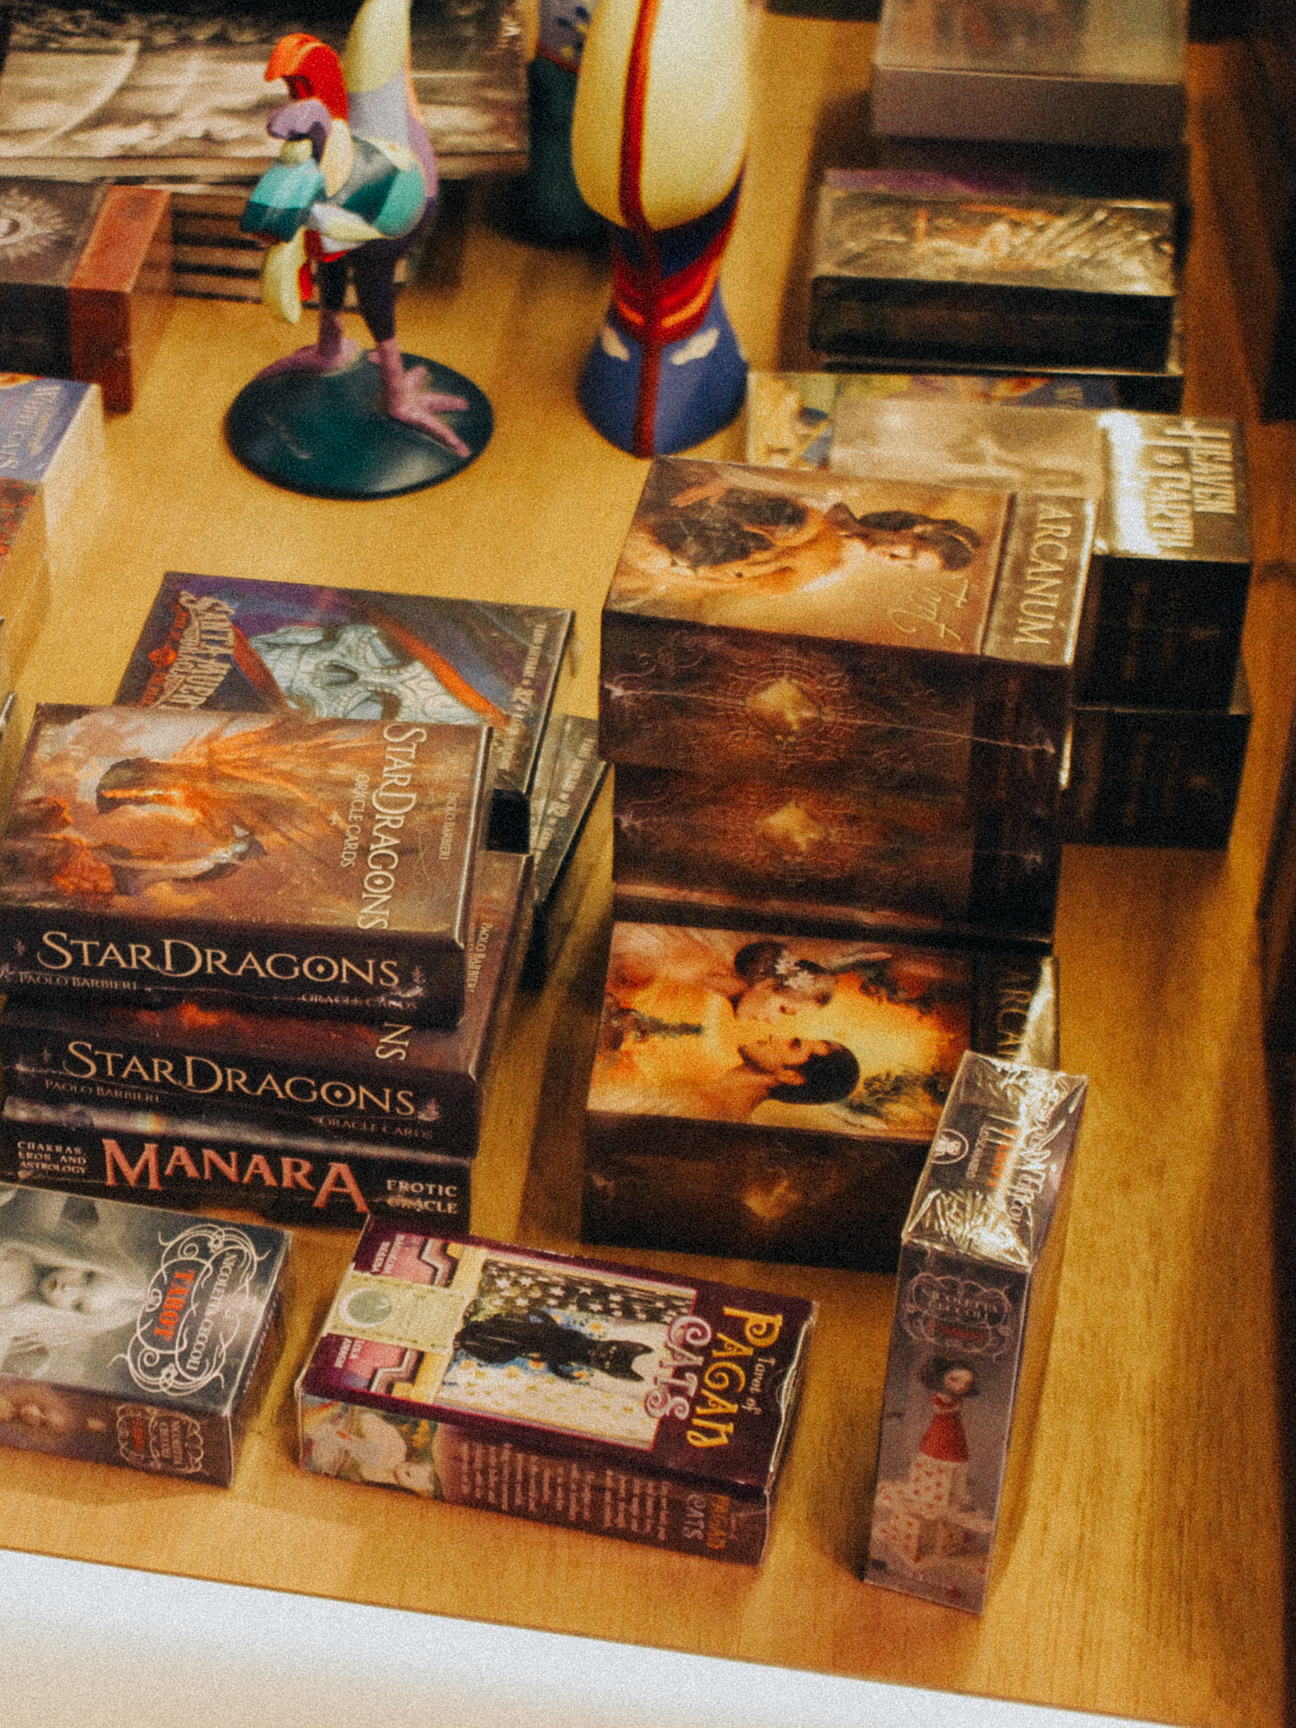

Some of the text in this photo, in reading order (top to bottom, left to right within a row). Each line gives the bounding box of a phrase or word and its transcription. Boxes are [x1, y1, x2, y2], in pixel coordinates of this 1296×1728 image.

[1142, 420, 1237, 514] HEAVEN
[1013, 502, 1073, 645] ARCANUM
[340, 773, 370, 868] ORACLE CARDS
[18, 973, 138, 991] PAOLO BARBIERI
[44, 1079, 160, 1103] PAOLO BARBIERI
[317, 1116, 434, 1140] ORACLE CARDS
[18, 1151, 87, 1166] EROS AND
[19, 1160, 87, 1175] ASTROLOGY
[101, 1138, 370, 1214] MANARA
[386, 1179, 458, 1198] EROTIC
[386, 1195, 458, 1214] ORACLE
[153, 1269, 196, 1342] TAROT
[644, 1315, 712, 1420] CATS
[686, 1306, 783, 1448] PAGAN
[741, 1357, 776, 1415] Tarot of
